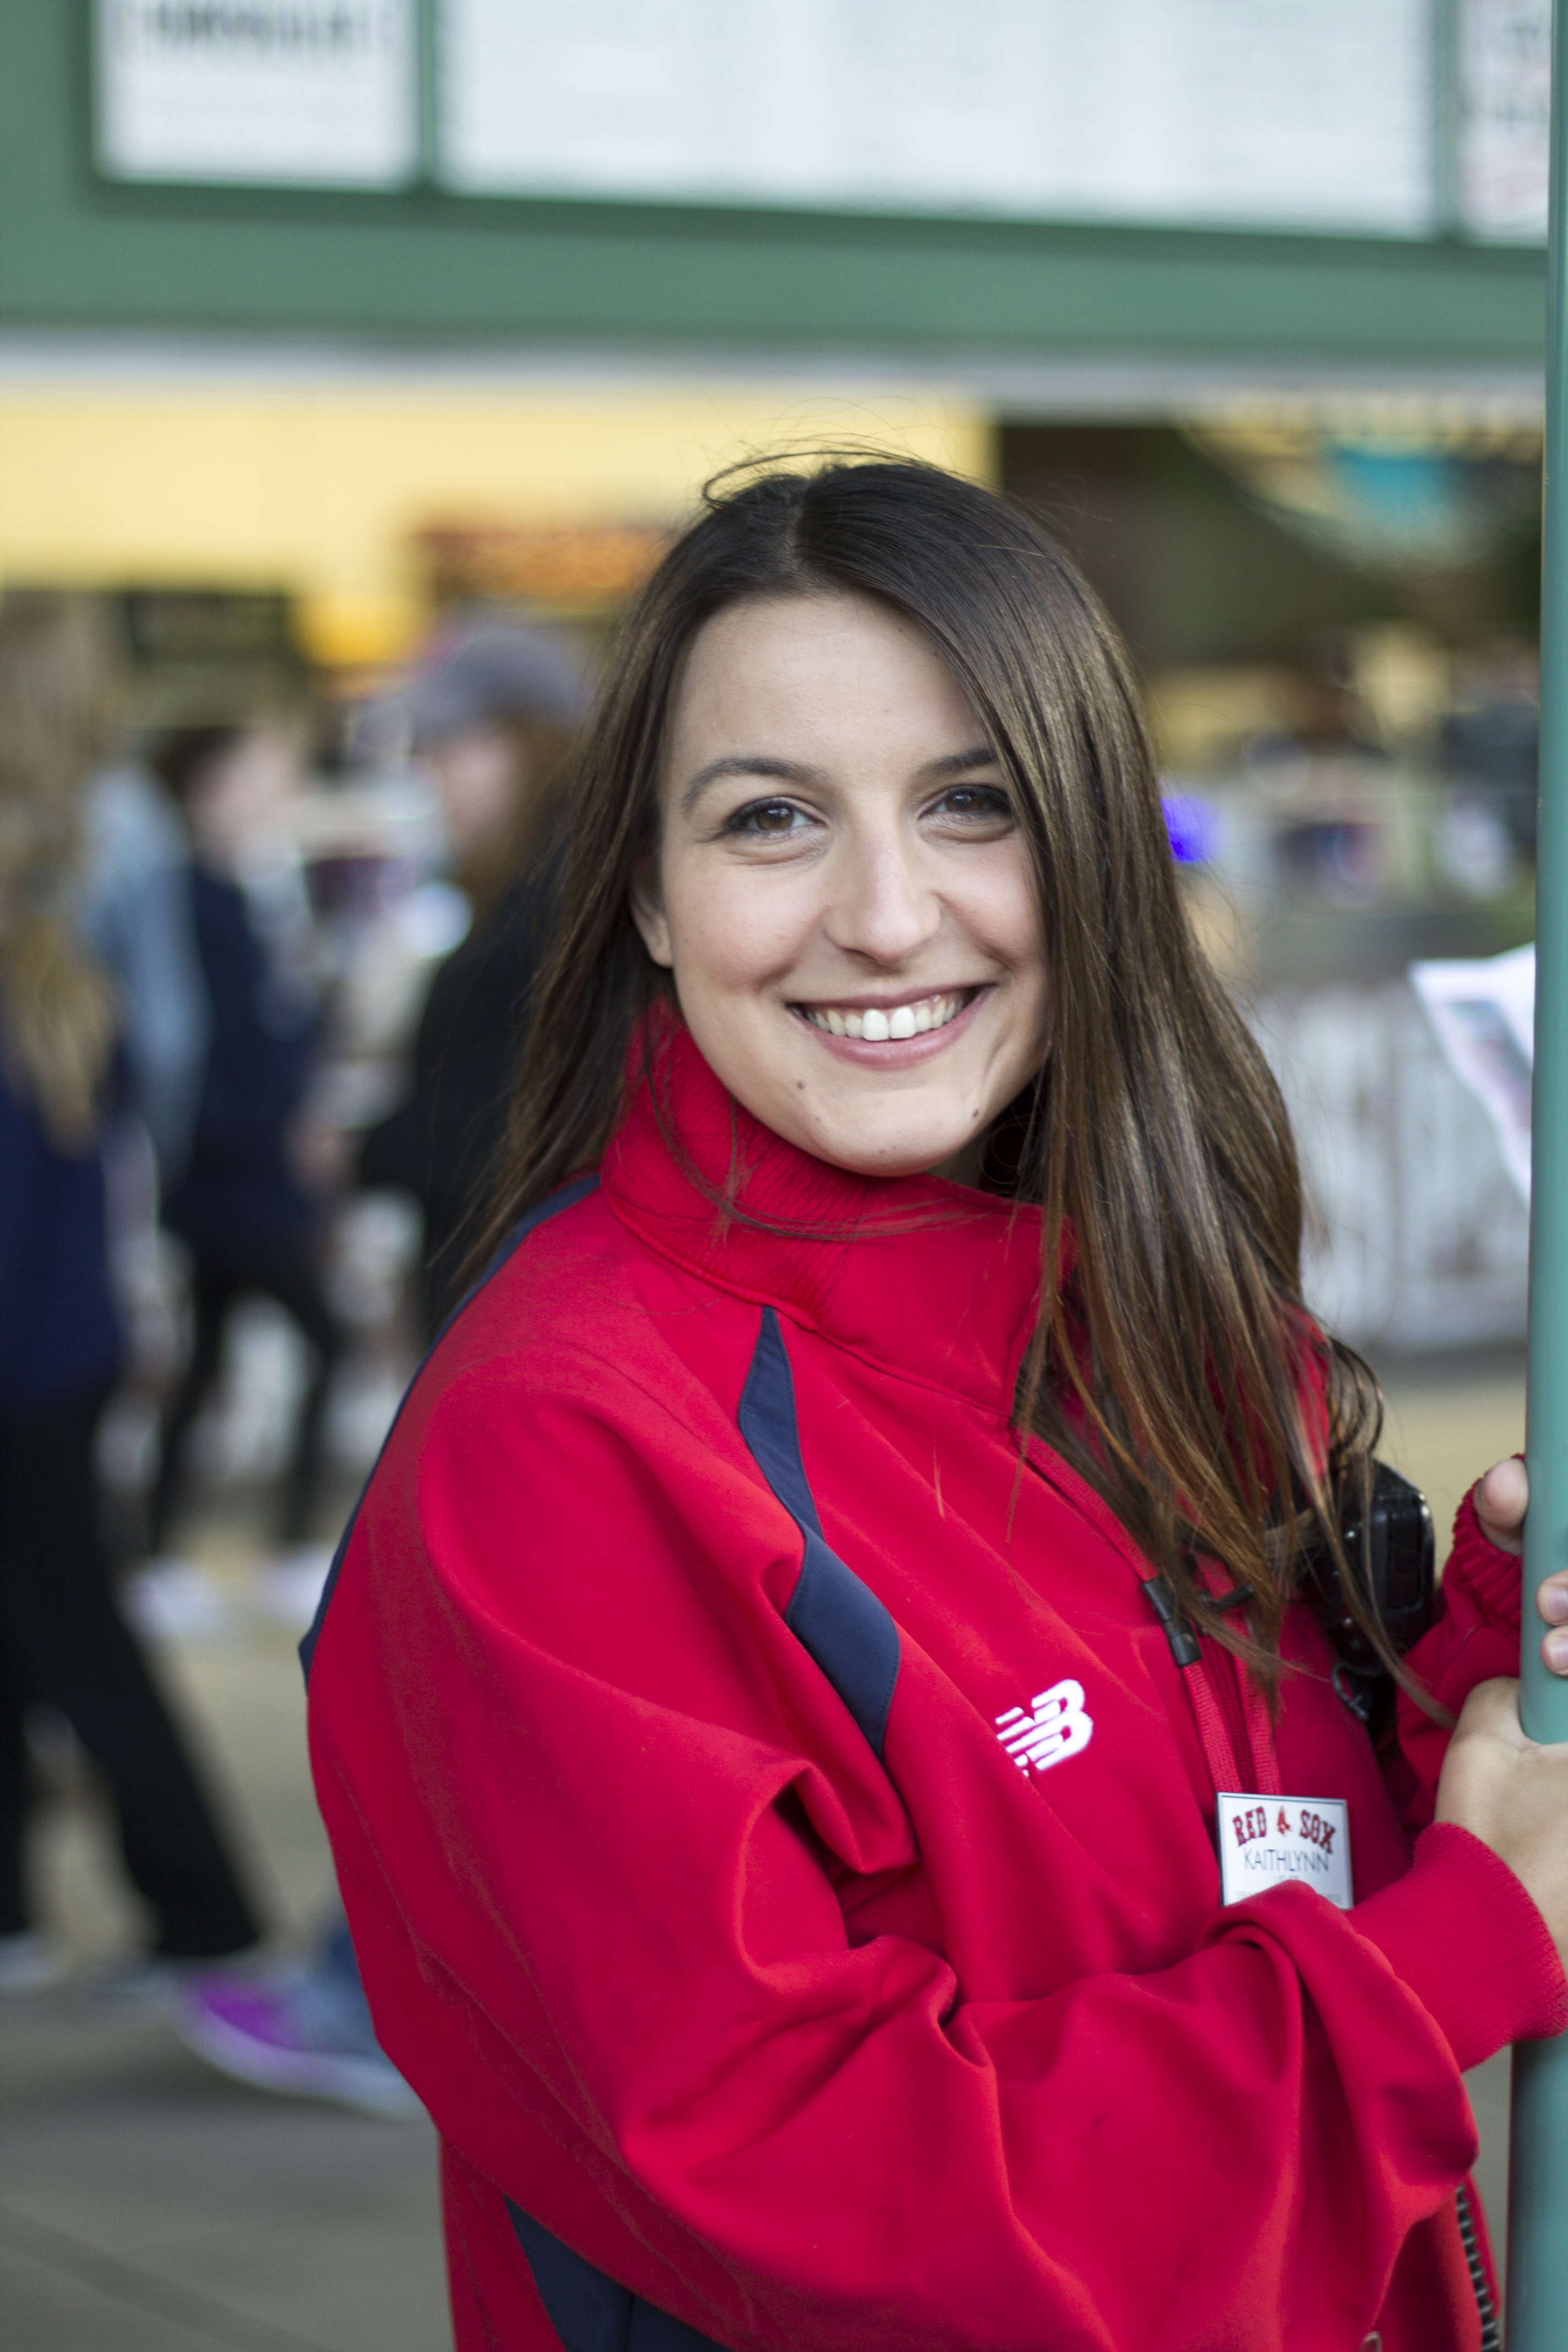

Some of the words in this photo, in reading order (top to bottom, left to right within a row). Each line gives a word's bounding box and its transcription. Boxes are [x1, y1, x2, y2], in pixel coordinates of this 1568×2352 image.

[1233, 1806, 1267, 1847] RED
[1299, 1809, 1336, 1854] SOX
[1244, 1849, 1329, 1872] KAITHLYNN
